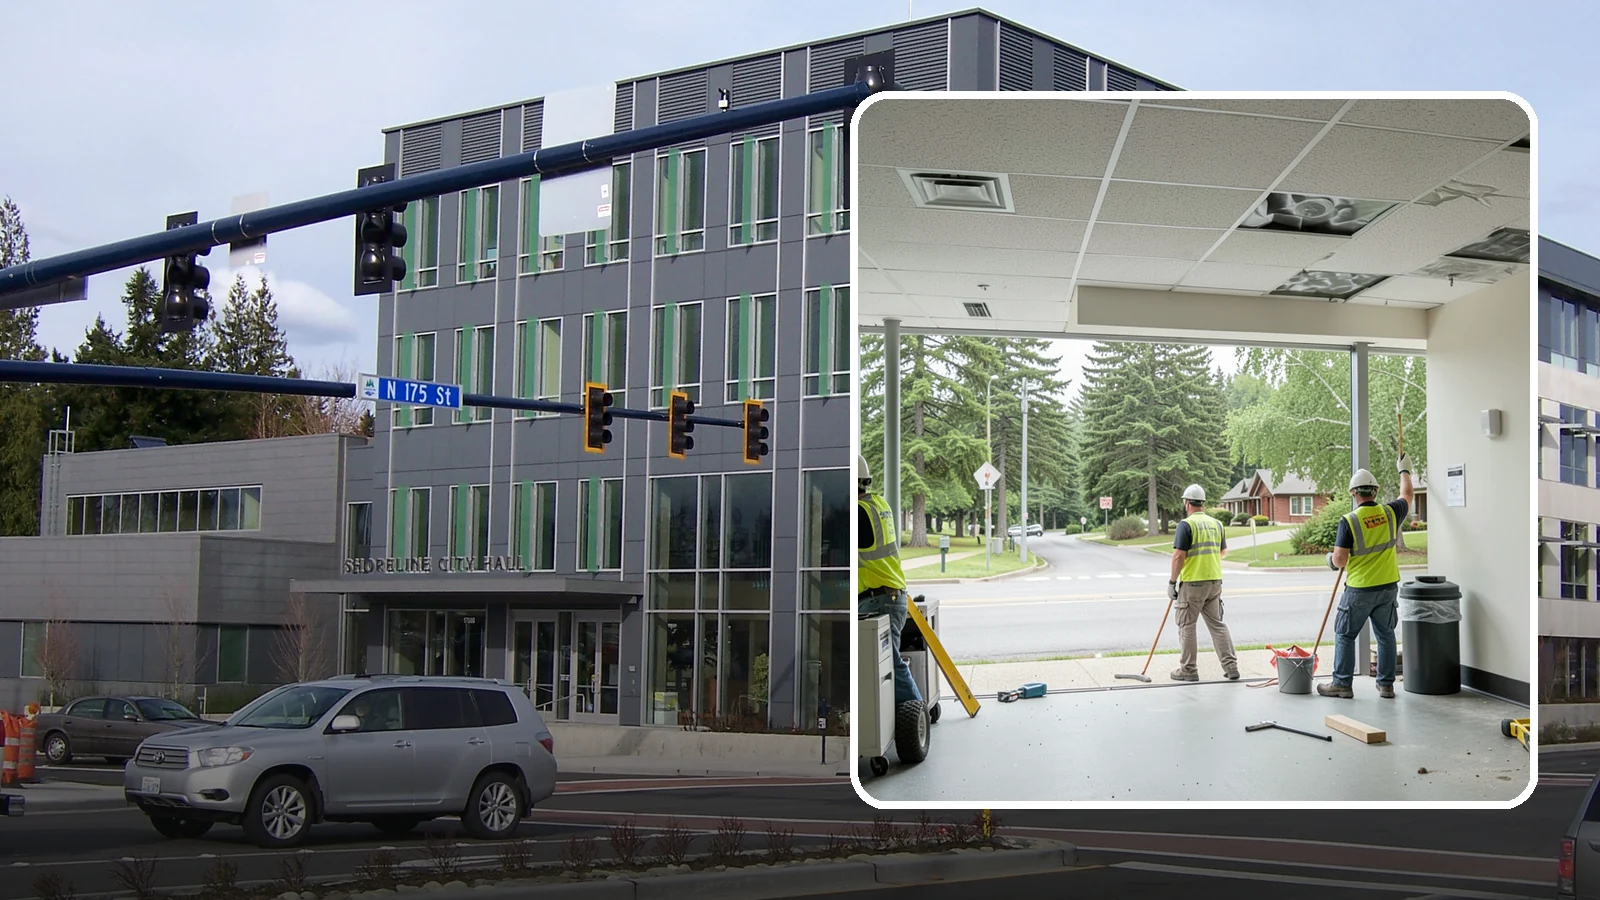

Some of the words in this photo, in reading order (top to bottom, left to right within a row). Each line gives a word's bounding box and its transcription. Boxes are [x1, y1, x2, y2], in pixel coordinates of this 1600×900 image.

[387, 380, 396, 400] N
[405, 382, 427, 403] 175
[436, 386, 451, 406] St
[344, 557, 432, 574] SHORELINE
[438, 556, 476, 572] CITY
[484, 555, 525, 571] HALL
